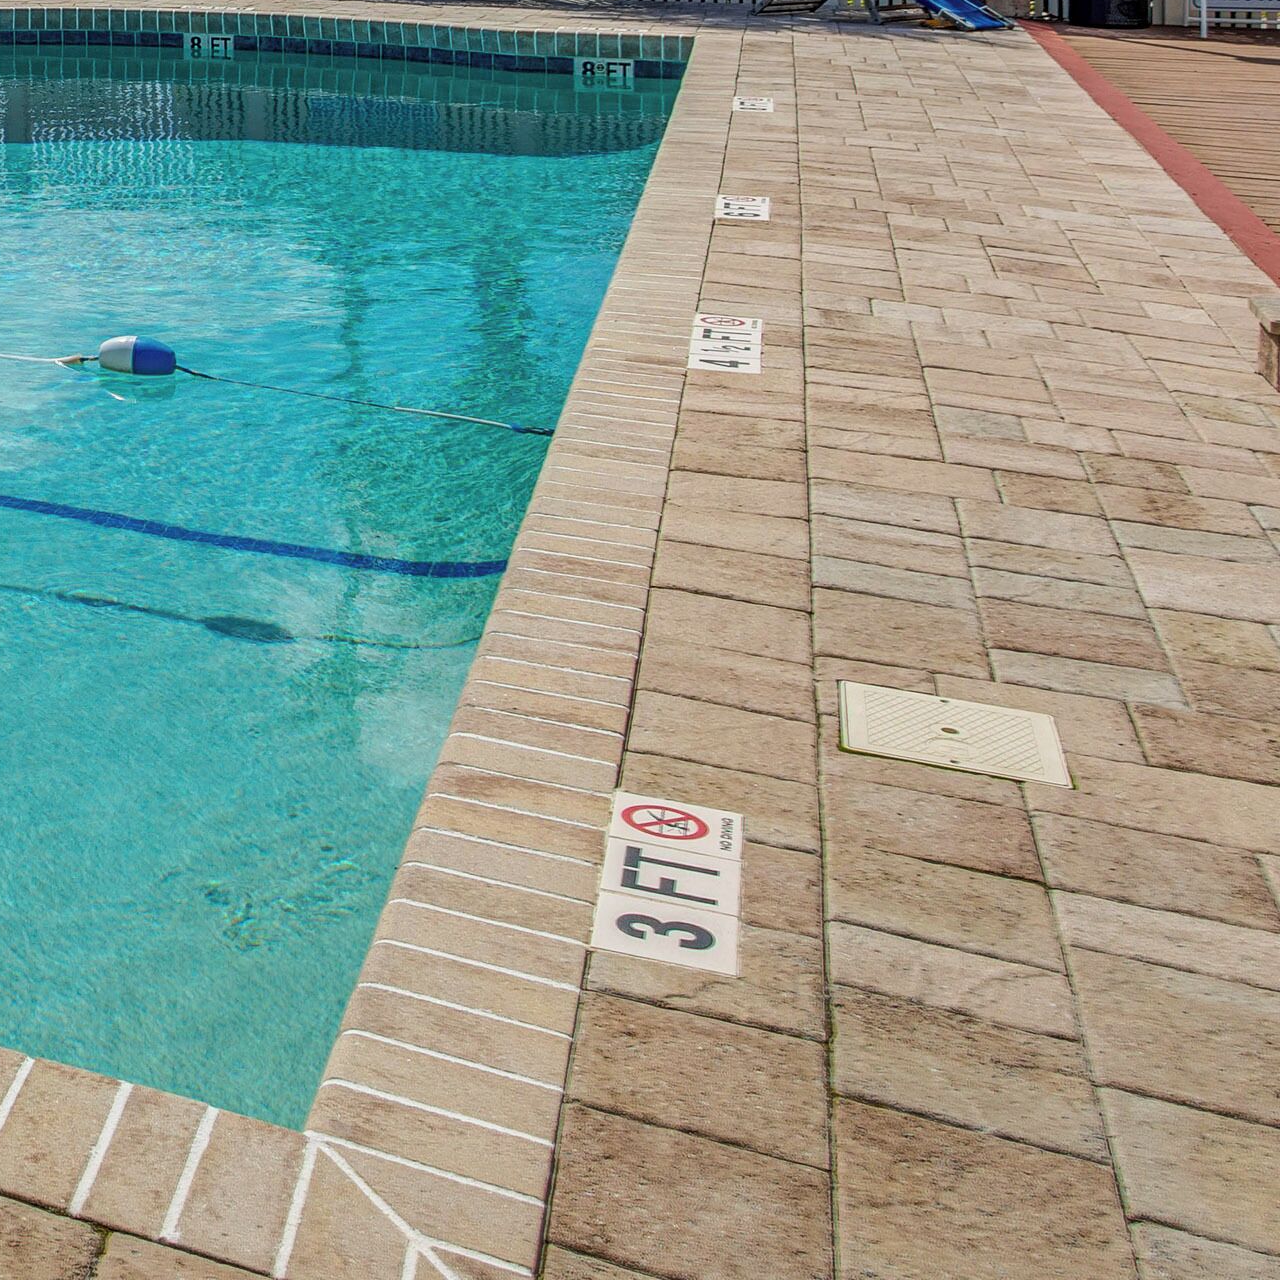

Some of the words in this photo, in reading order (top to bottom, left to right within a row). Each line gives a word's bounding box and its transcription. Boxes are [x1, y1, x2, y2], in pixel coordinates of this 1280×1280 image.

[606, 62, 631, 78] FT
[702, 328, 752, 342] FT
[698, 358, 750, 368] 4
[719, 840, 733, 852] NO
[620, 844, 721, 906] FT
[615, 912, 717, 951] 3
